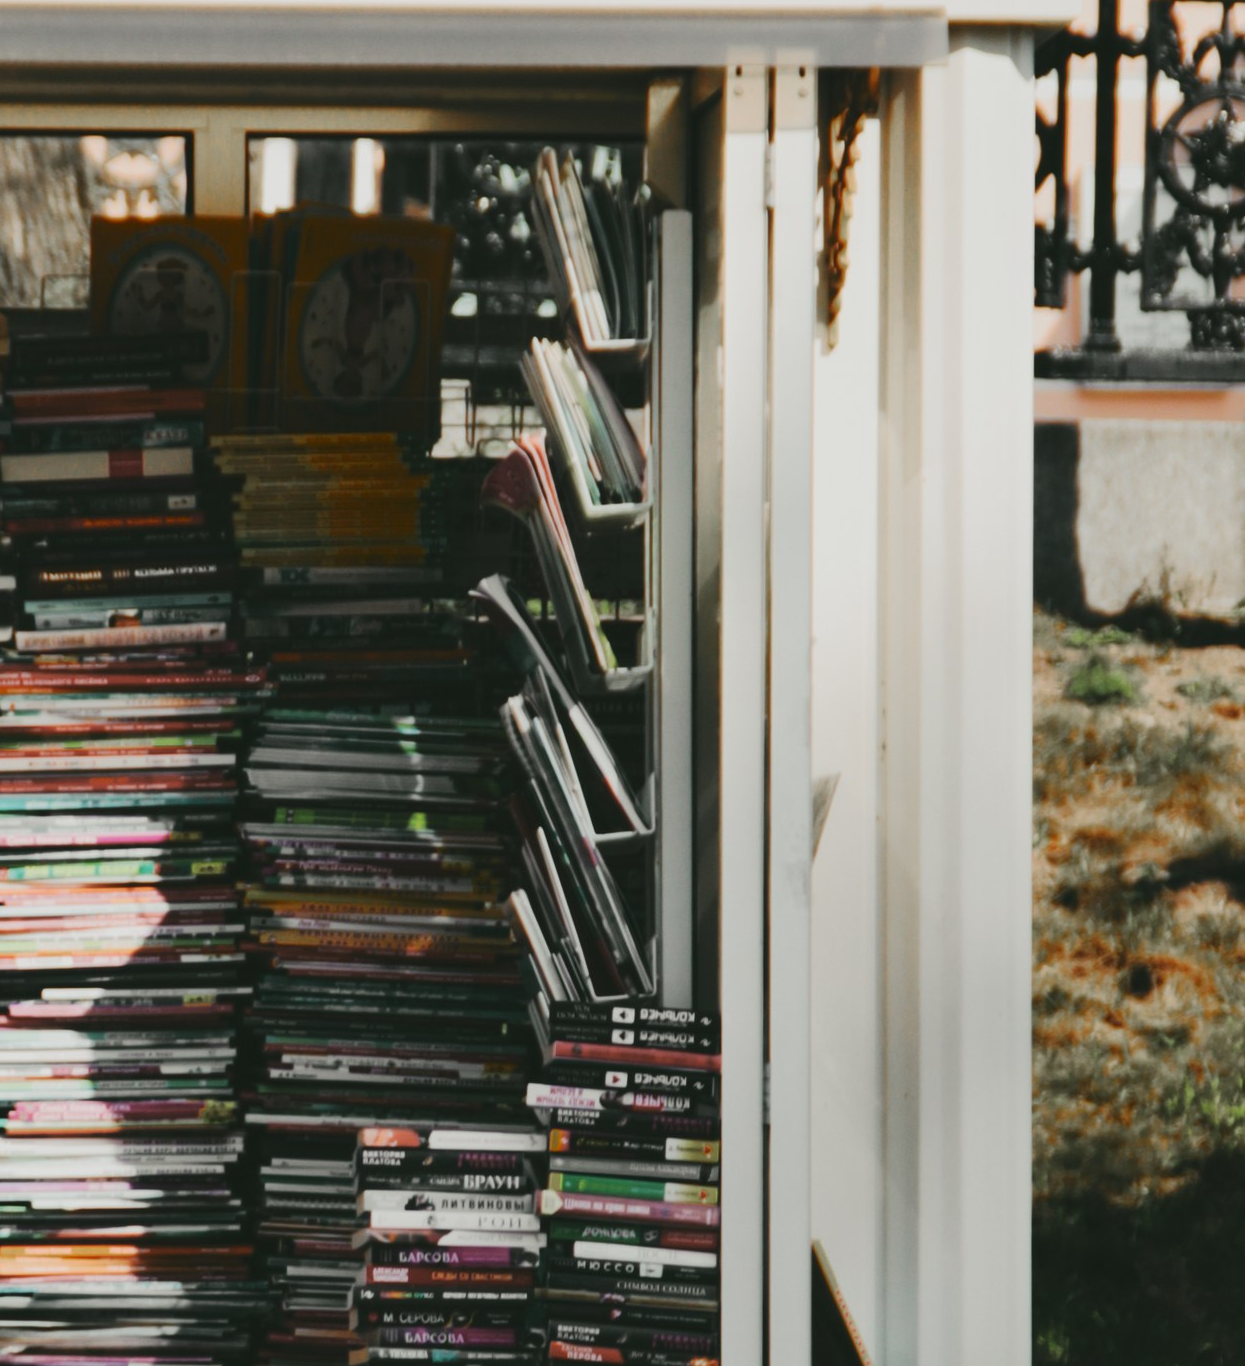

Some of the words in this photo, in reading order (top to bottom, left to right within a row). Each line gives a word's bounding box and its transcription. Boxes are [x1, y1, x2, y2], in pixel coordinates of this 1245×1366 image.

[362, 1149, 405, 1159] ВИКТОРИЯ
[362, 1158, 401, 1166] ПЛАТОВА
[463, 1174, 520, 1190] БРАУН
[441, 1198, 525, 1211] ЛИТВИНОВЫ
[582, 1226, 636, 1239] ДОНЦОВА
[399, 1252, 459, 1263] БАРСОВА
[576, 1260, 635, 1273] МЮССО
[616, 1280, 660, 1292] СИМВОЛ
[662, 1283, 706, 1296] СОЛНЦА
[399, 1311, 445, 1323] СЕРОВА
[557, 1324, 601, 1335] ВИКТОРИЯ
[404, 1332, 465, 1344] БАРСОВА
[566, 1350, 603, 1362] ПЕРОВА
